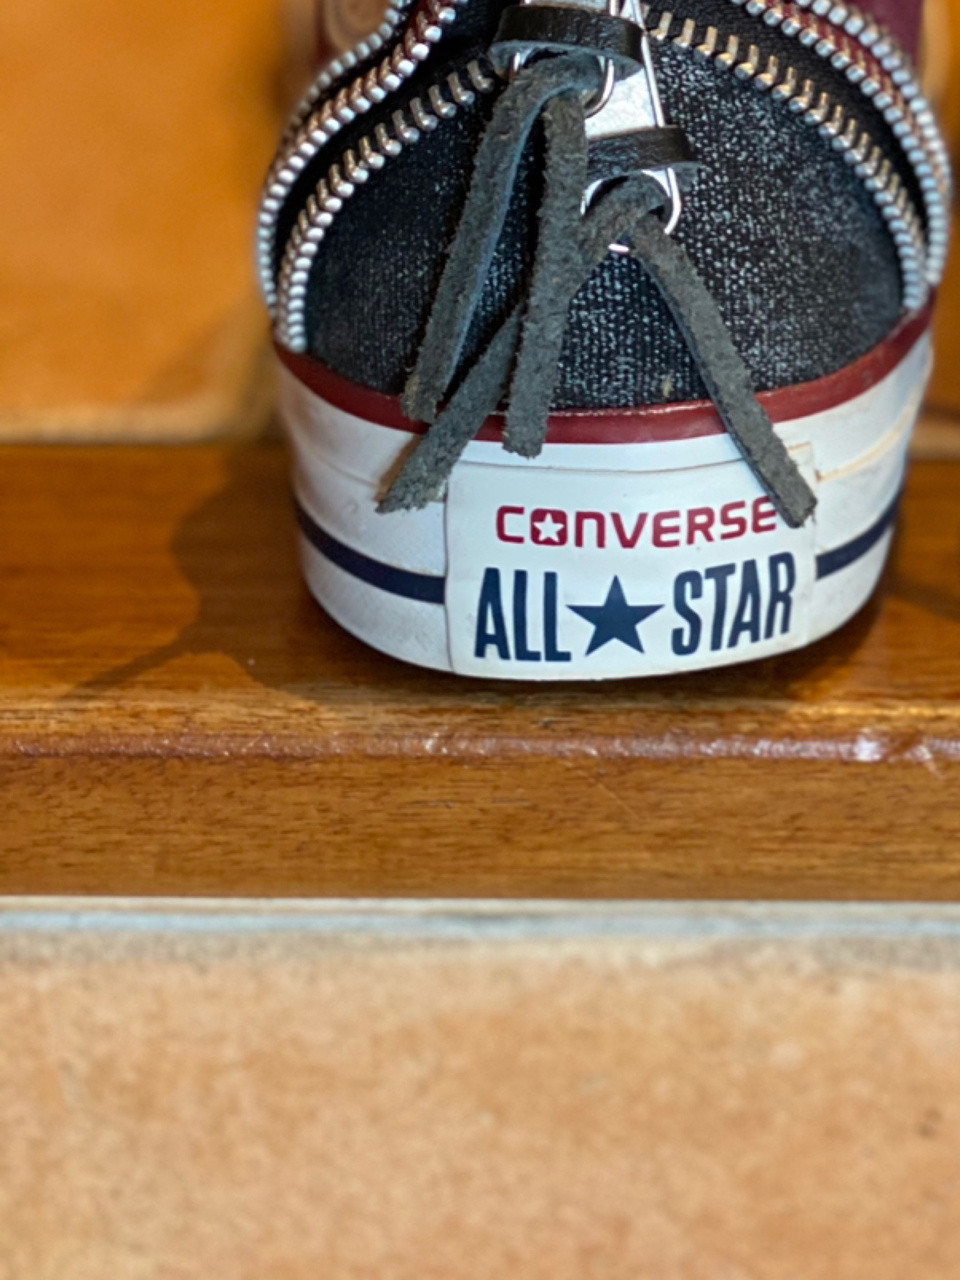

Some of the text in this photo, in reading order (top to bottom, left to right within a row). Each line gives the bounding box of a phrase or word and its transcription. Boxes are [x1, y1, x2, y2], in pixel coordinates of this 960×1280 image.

[494, 494, 777, 549] CONVERSE
[474, 551, 796, 663] ALL STAR
